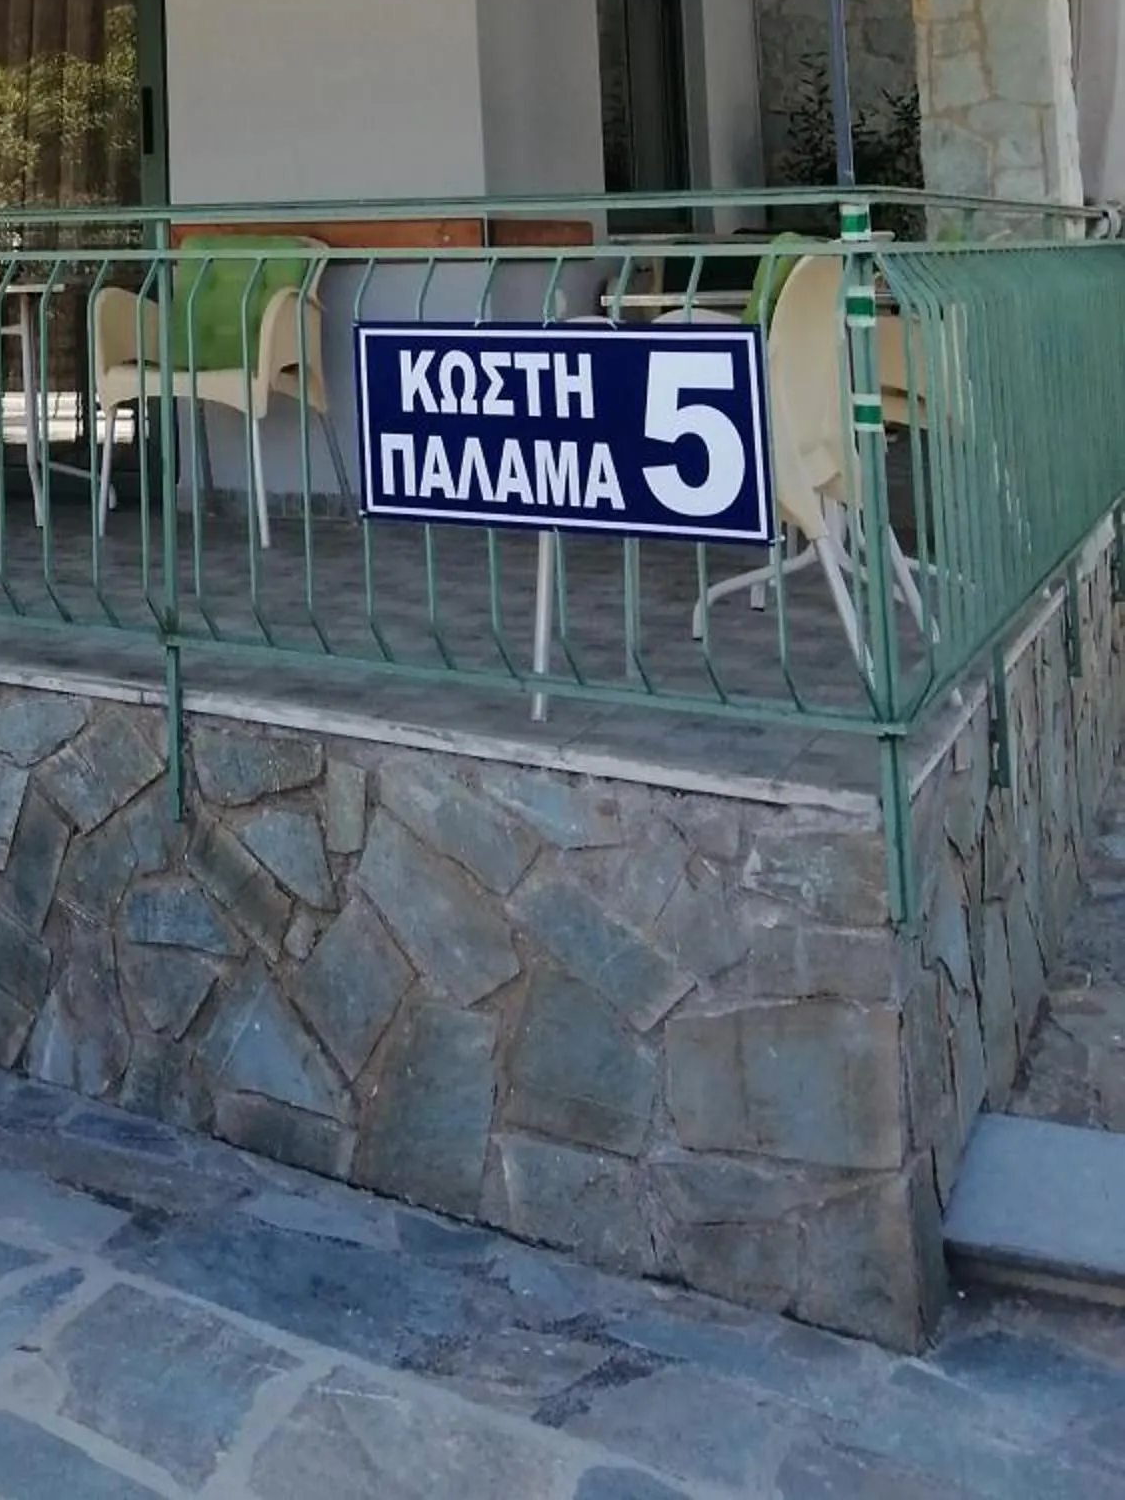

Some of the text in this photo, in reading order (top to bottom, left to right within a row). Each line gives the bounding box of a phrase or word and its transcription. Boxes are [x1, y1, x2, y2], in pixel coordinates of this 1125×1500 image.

[398, 349, 595, 419] ΚΩΣΤΗ
[380, 433, 626, 510] ΠΑΛΑΜΑ
[642, 351, 745, 517] 5
